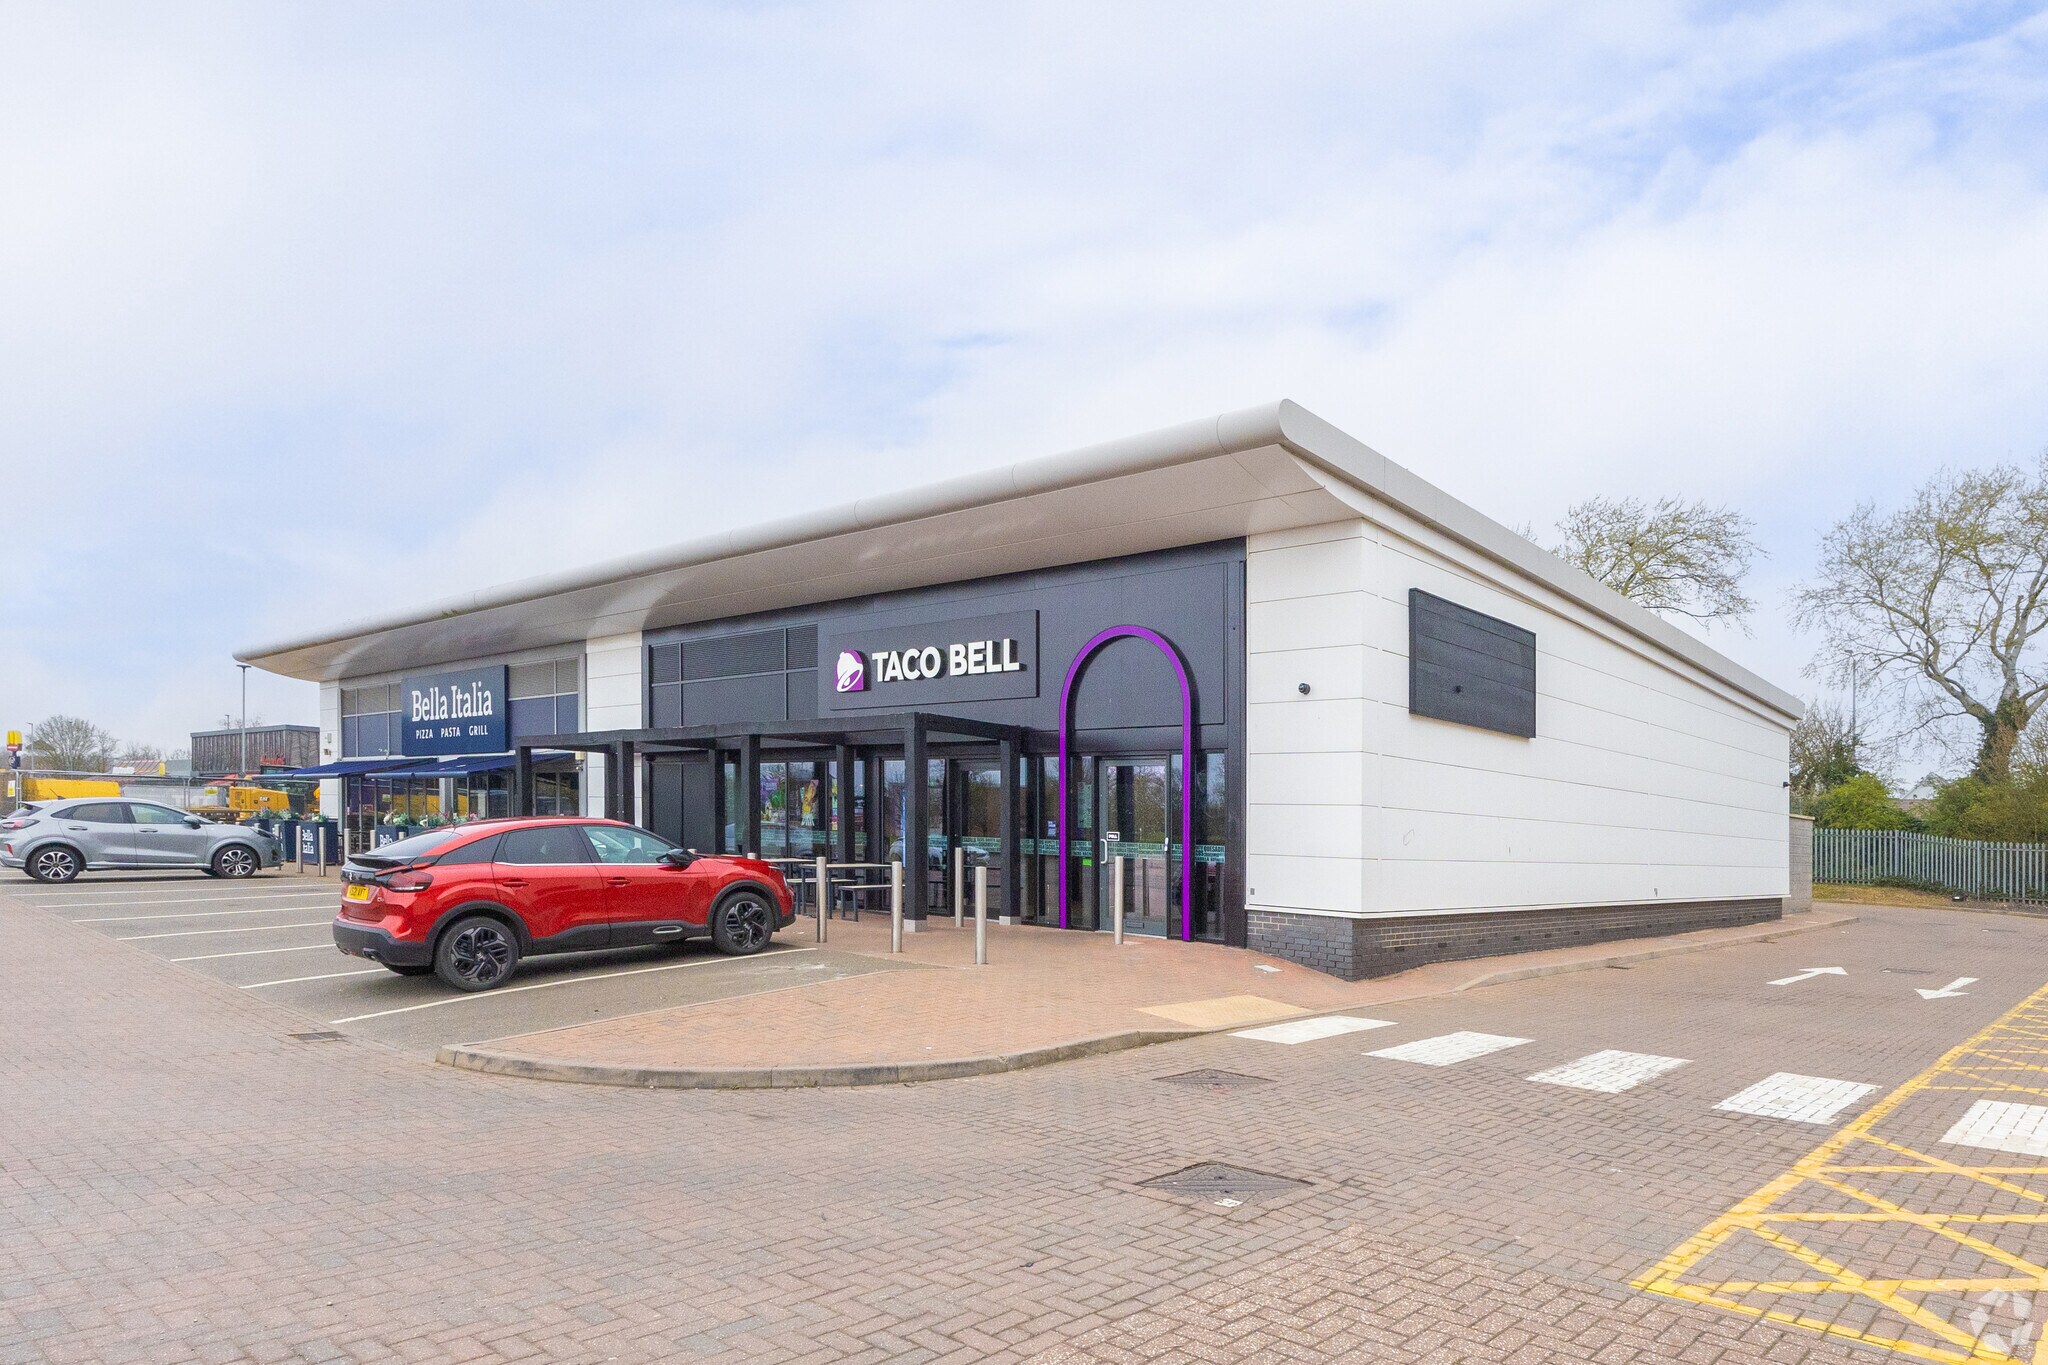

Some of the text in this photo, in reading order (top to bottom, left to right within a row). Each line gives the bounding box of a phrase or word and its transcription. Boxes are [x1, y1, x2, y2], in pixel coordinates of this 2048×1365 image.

[872, 638, 1020, 682] TACO BELL
[411, 681, 493, 722] Bella Italia
[416, 725, 488, 739] PIZZA PASTA GRILL
[302, 842, 315, 854] talia
